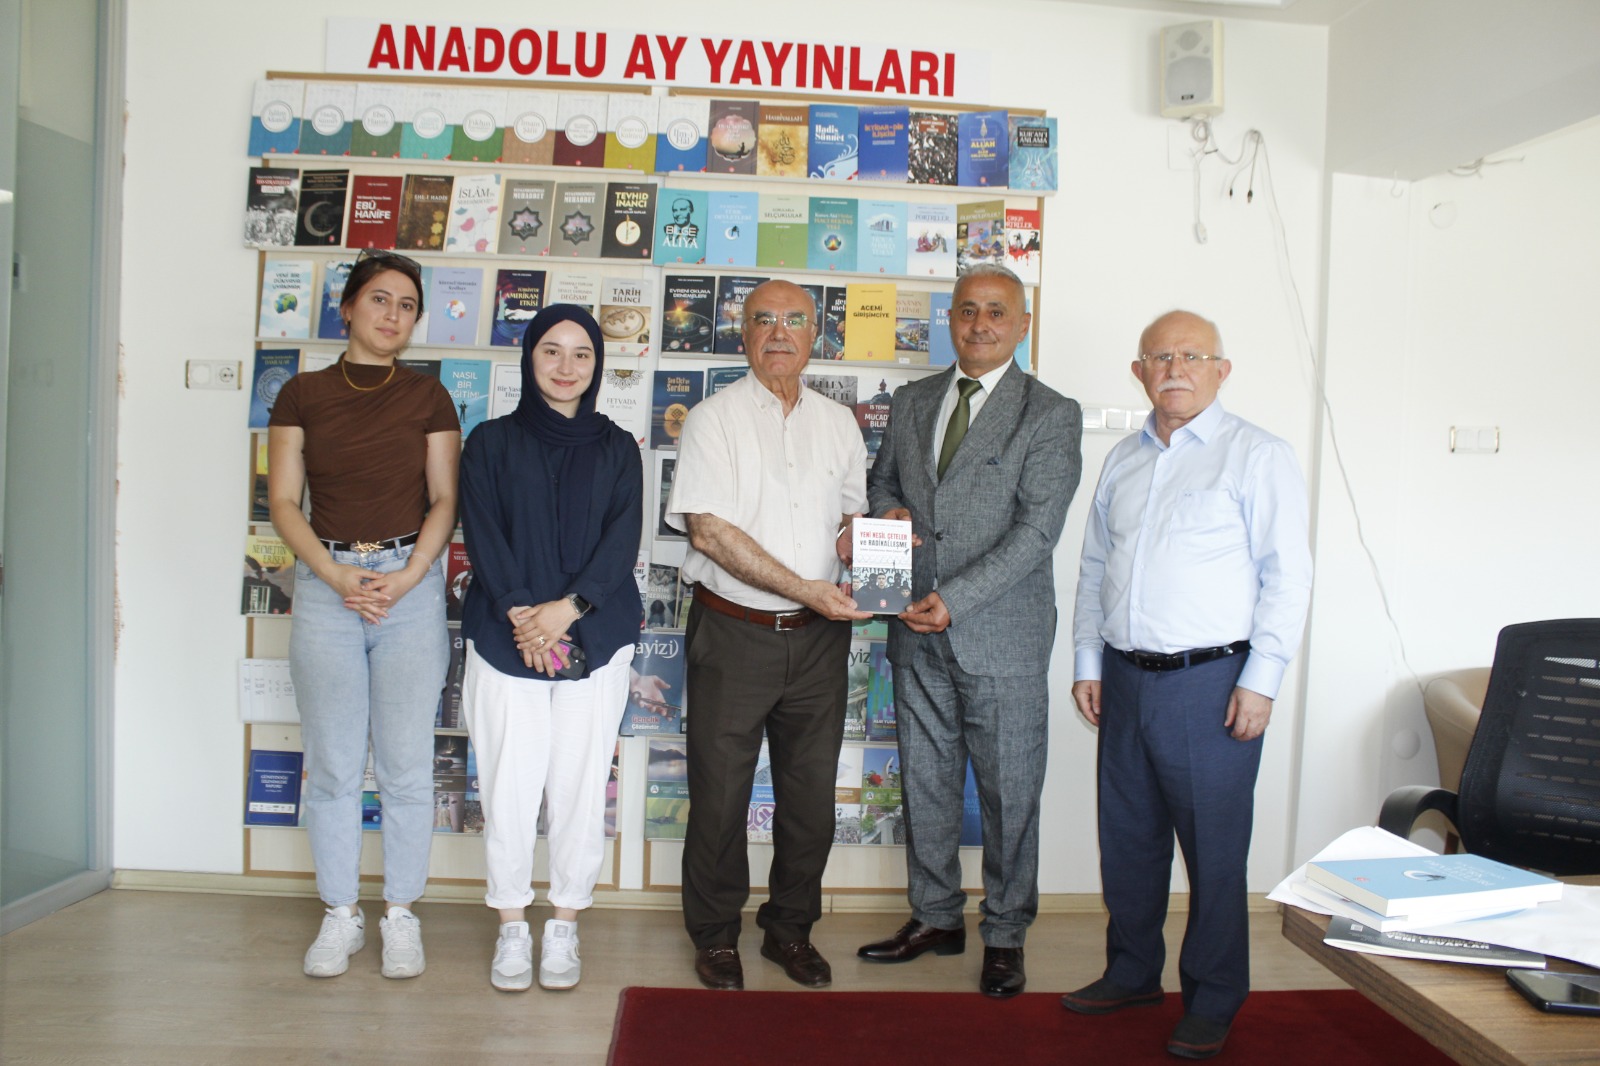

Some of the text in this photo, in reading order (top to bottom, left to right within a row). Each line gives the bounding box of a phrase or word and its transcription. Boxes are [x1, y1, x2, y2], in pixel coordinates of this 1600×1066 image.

[368, 24, 954, 97] ANADOLU AY YAYINLARI
[815, 124, 839, 134] Hadis
[815, 133, 845, 142] Sünnet
[970, 141, 996, 149] ALLAH
[505, 292, 540, 300] AMERİKAN
[612, 287, 642, 297] TARİH
[612, 295, 641, 304] BİLİNCİ
[860, 303, 883, 311] ACEMİ
[935, 318, 950, 326] DEV
[452, 371, 479, 380] NASIL
[457, 380, 472, 389] BİR
[864, 412, 889, 422] MÜCAD
[869, 421, 888, 429] BİLİN
[859, 530, 871, 539] YENİ
[886, 532, 908, 541] ÇETELER
[848, 648, 871, 668] yiz
